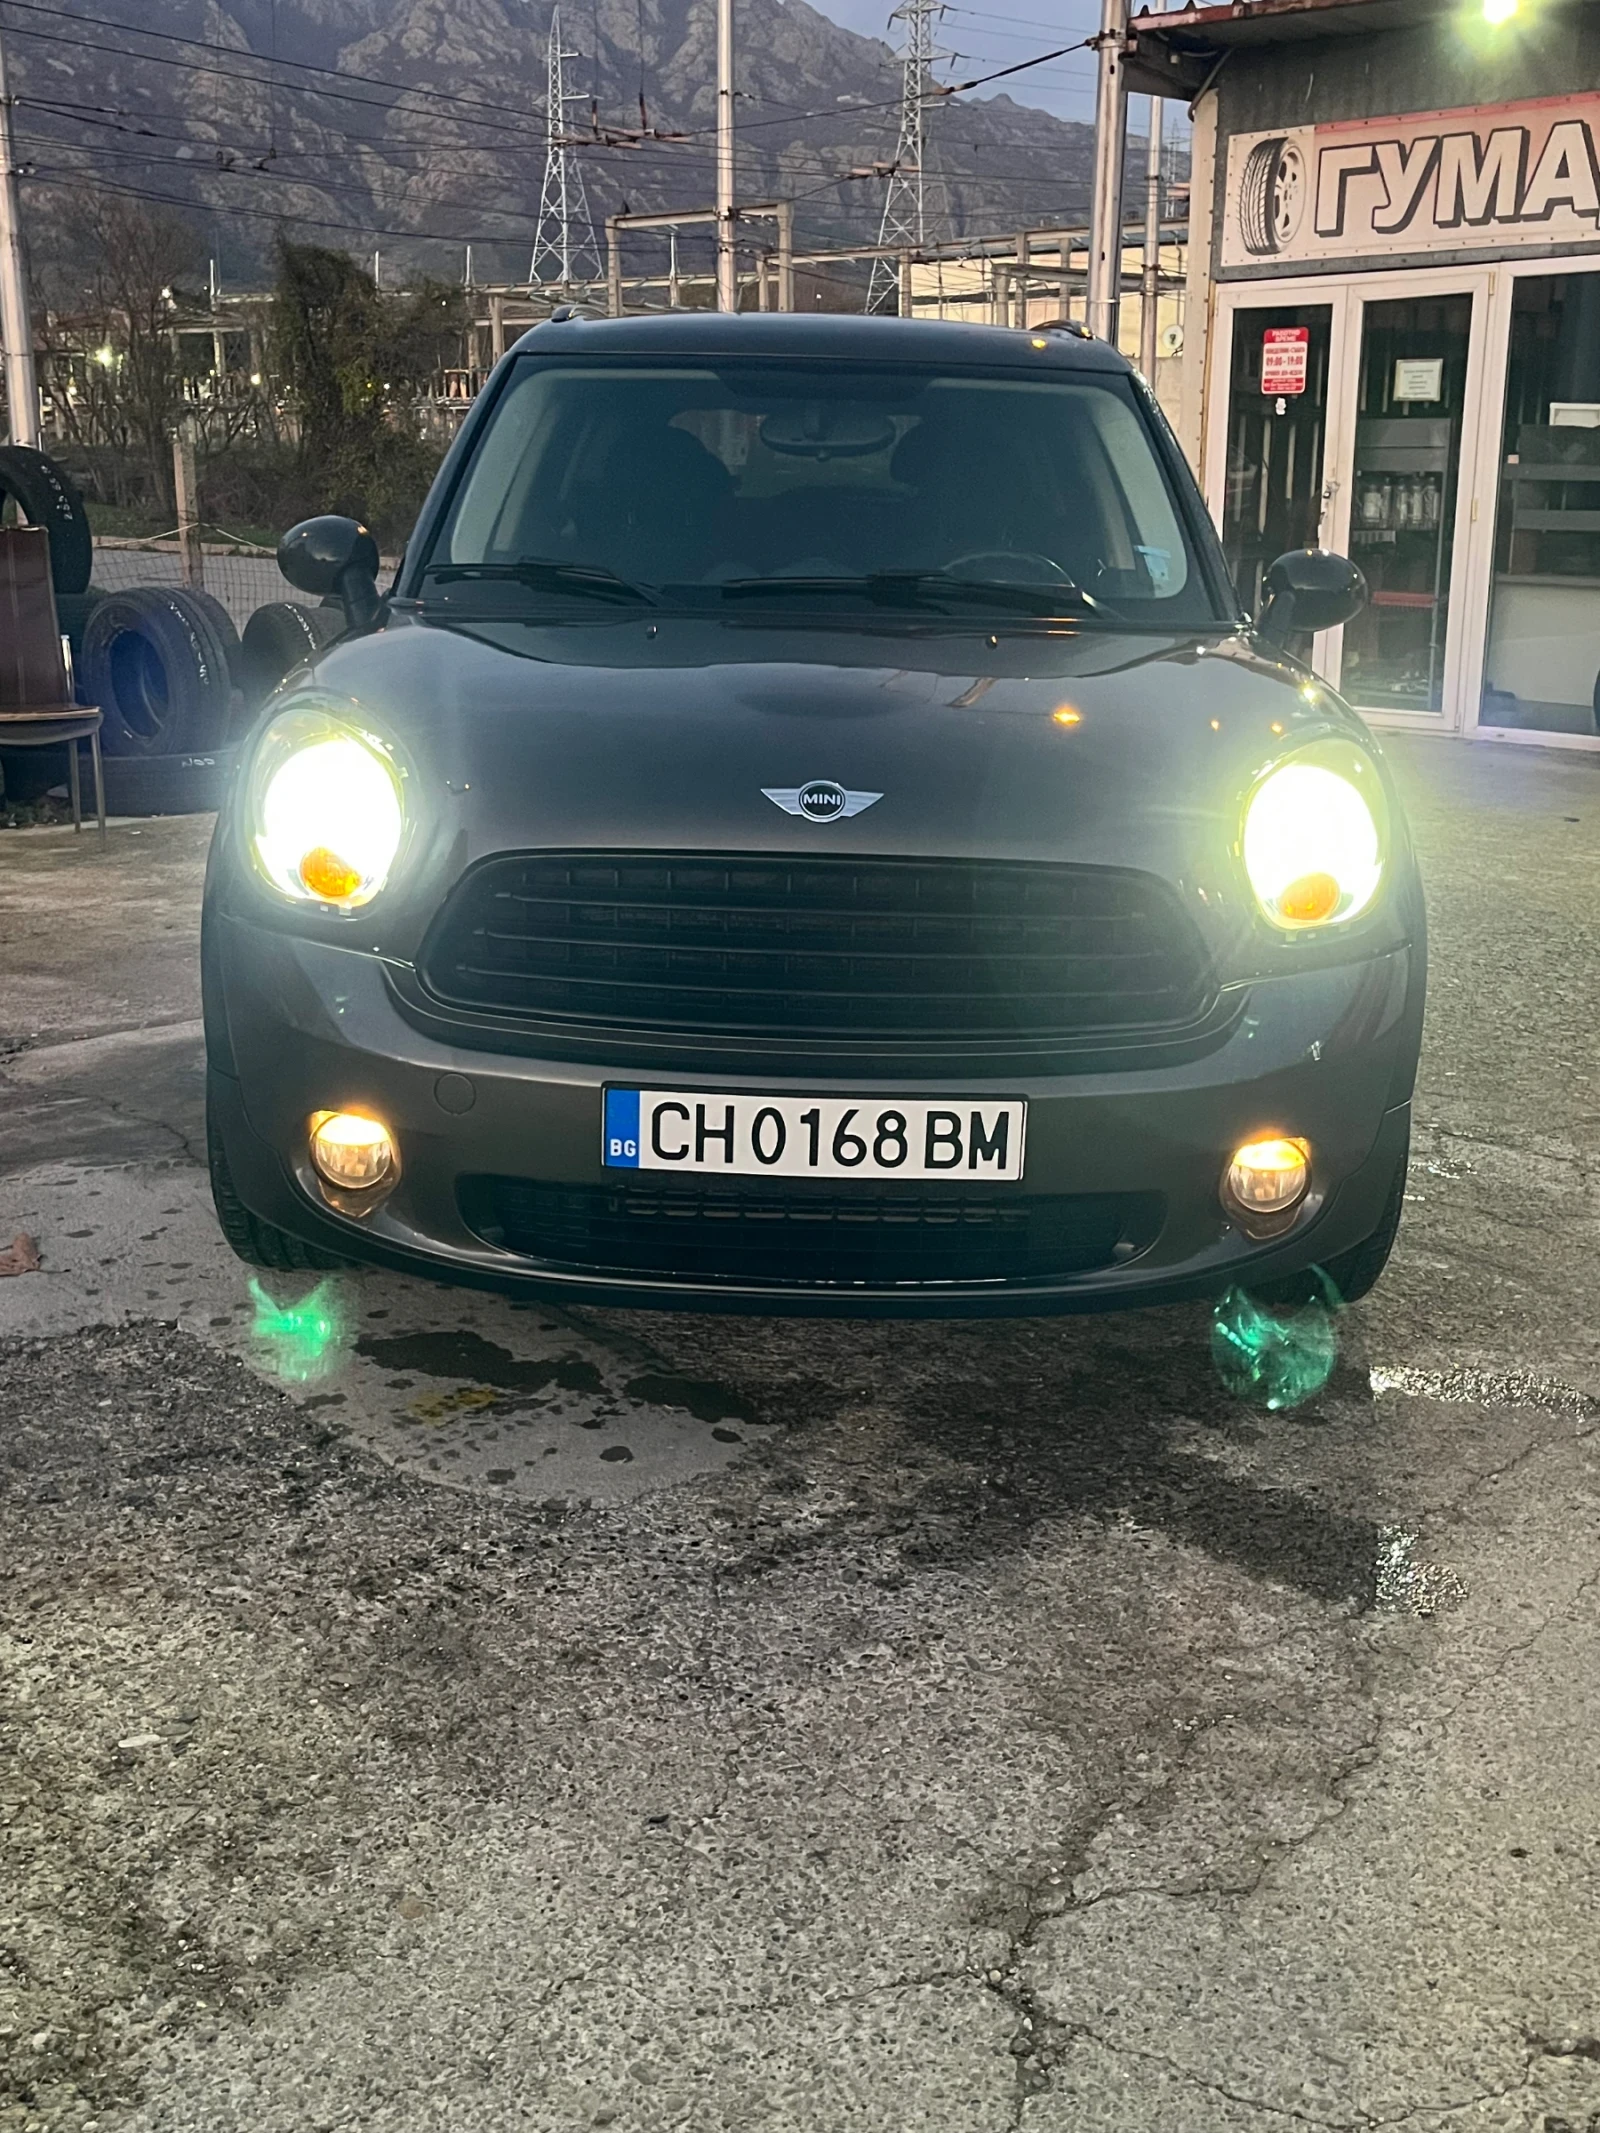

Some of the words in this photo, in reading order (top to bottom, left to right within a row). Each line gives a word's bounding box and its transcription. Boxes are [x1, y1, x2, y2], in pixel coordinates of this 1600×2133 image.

[1315, 119, 1600, 237] ГУМА
[803, 793, 841, 806] MINI
[610, 1138, 637, 1157] BG
[651, 1101, 735, 1164] CH
[751, 1106, 908, 1168] 0168
[924, 1110, 1010, 1170] BM
